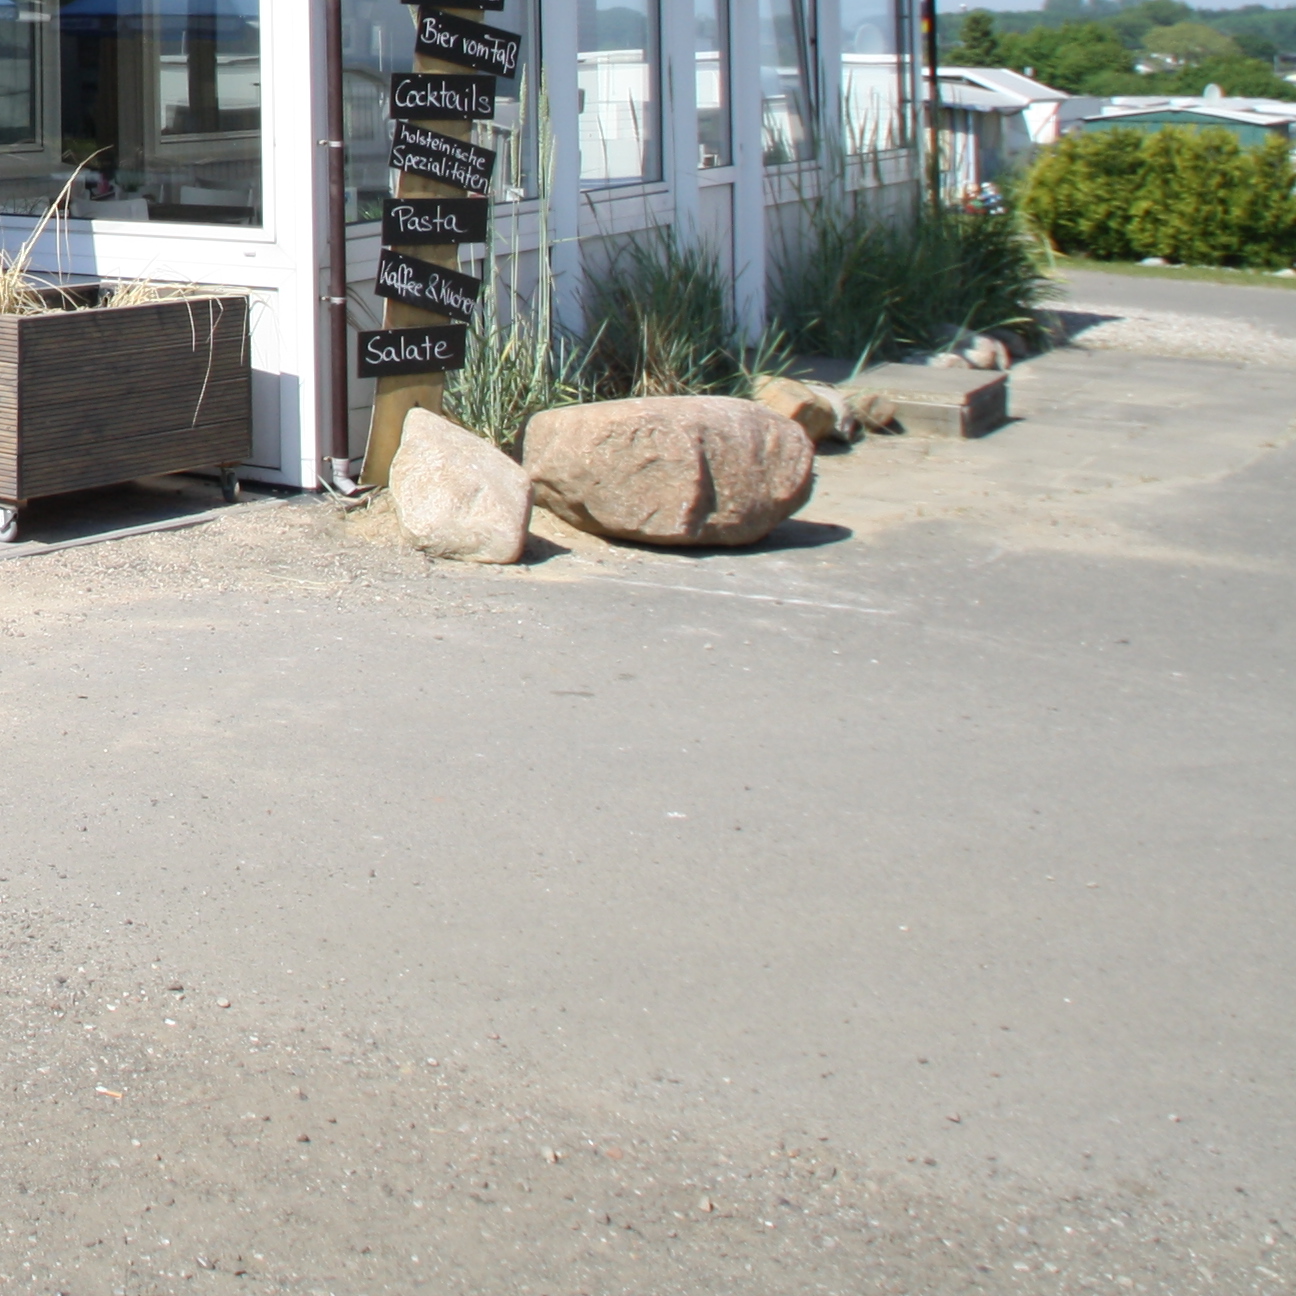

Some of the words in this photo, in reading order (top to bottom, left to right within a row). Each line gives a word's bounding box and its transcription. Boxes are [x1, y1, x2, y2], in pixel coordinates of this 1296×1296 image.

[420, 17, 459, 48] Bier
[462, 37, 489, 60] vom
[484, 33, 517, 74] Faß
[394, 79, 491, 113] Cocktails
[400, 124, 486, 170] holsteinische
[392, 145, 489, 194] Spezialitäten
[391, 205, 468, 234] Pasta
[379, 260, 423, 297] Kaffee
[425, 273, 439, 303] &
[364, 335, 454, 365] Salate
